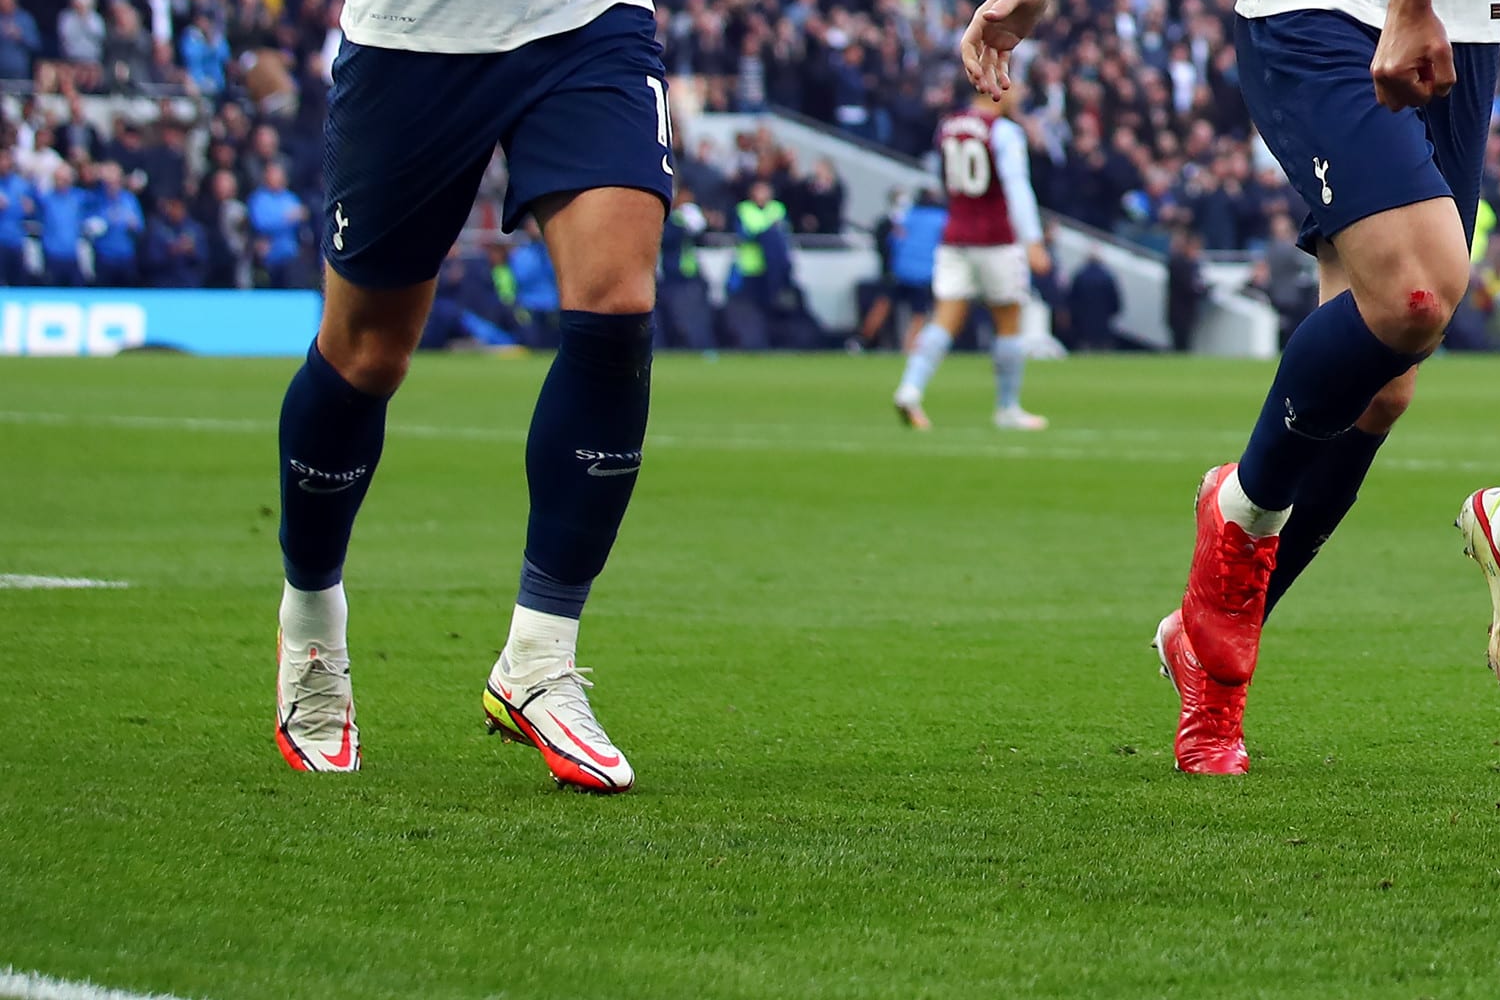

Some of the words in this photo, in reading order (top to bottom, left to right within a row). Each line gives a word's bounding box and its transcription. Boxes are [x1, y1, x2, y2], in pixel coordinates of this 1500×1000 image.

[647, 75, 672, 149] 1
[942, 137, 990, 197] 10
[290, 458, 367, 483] SPURS
